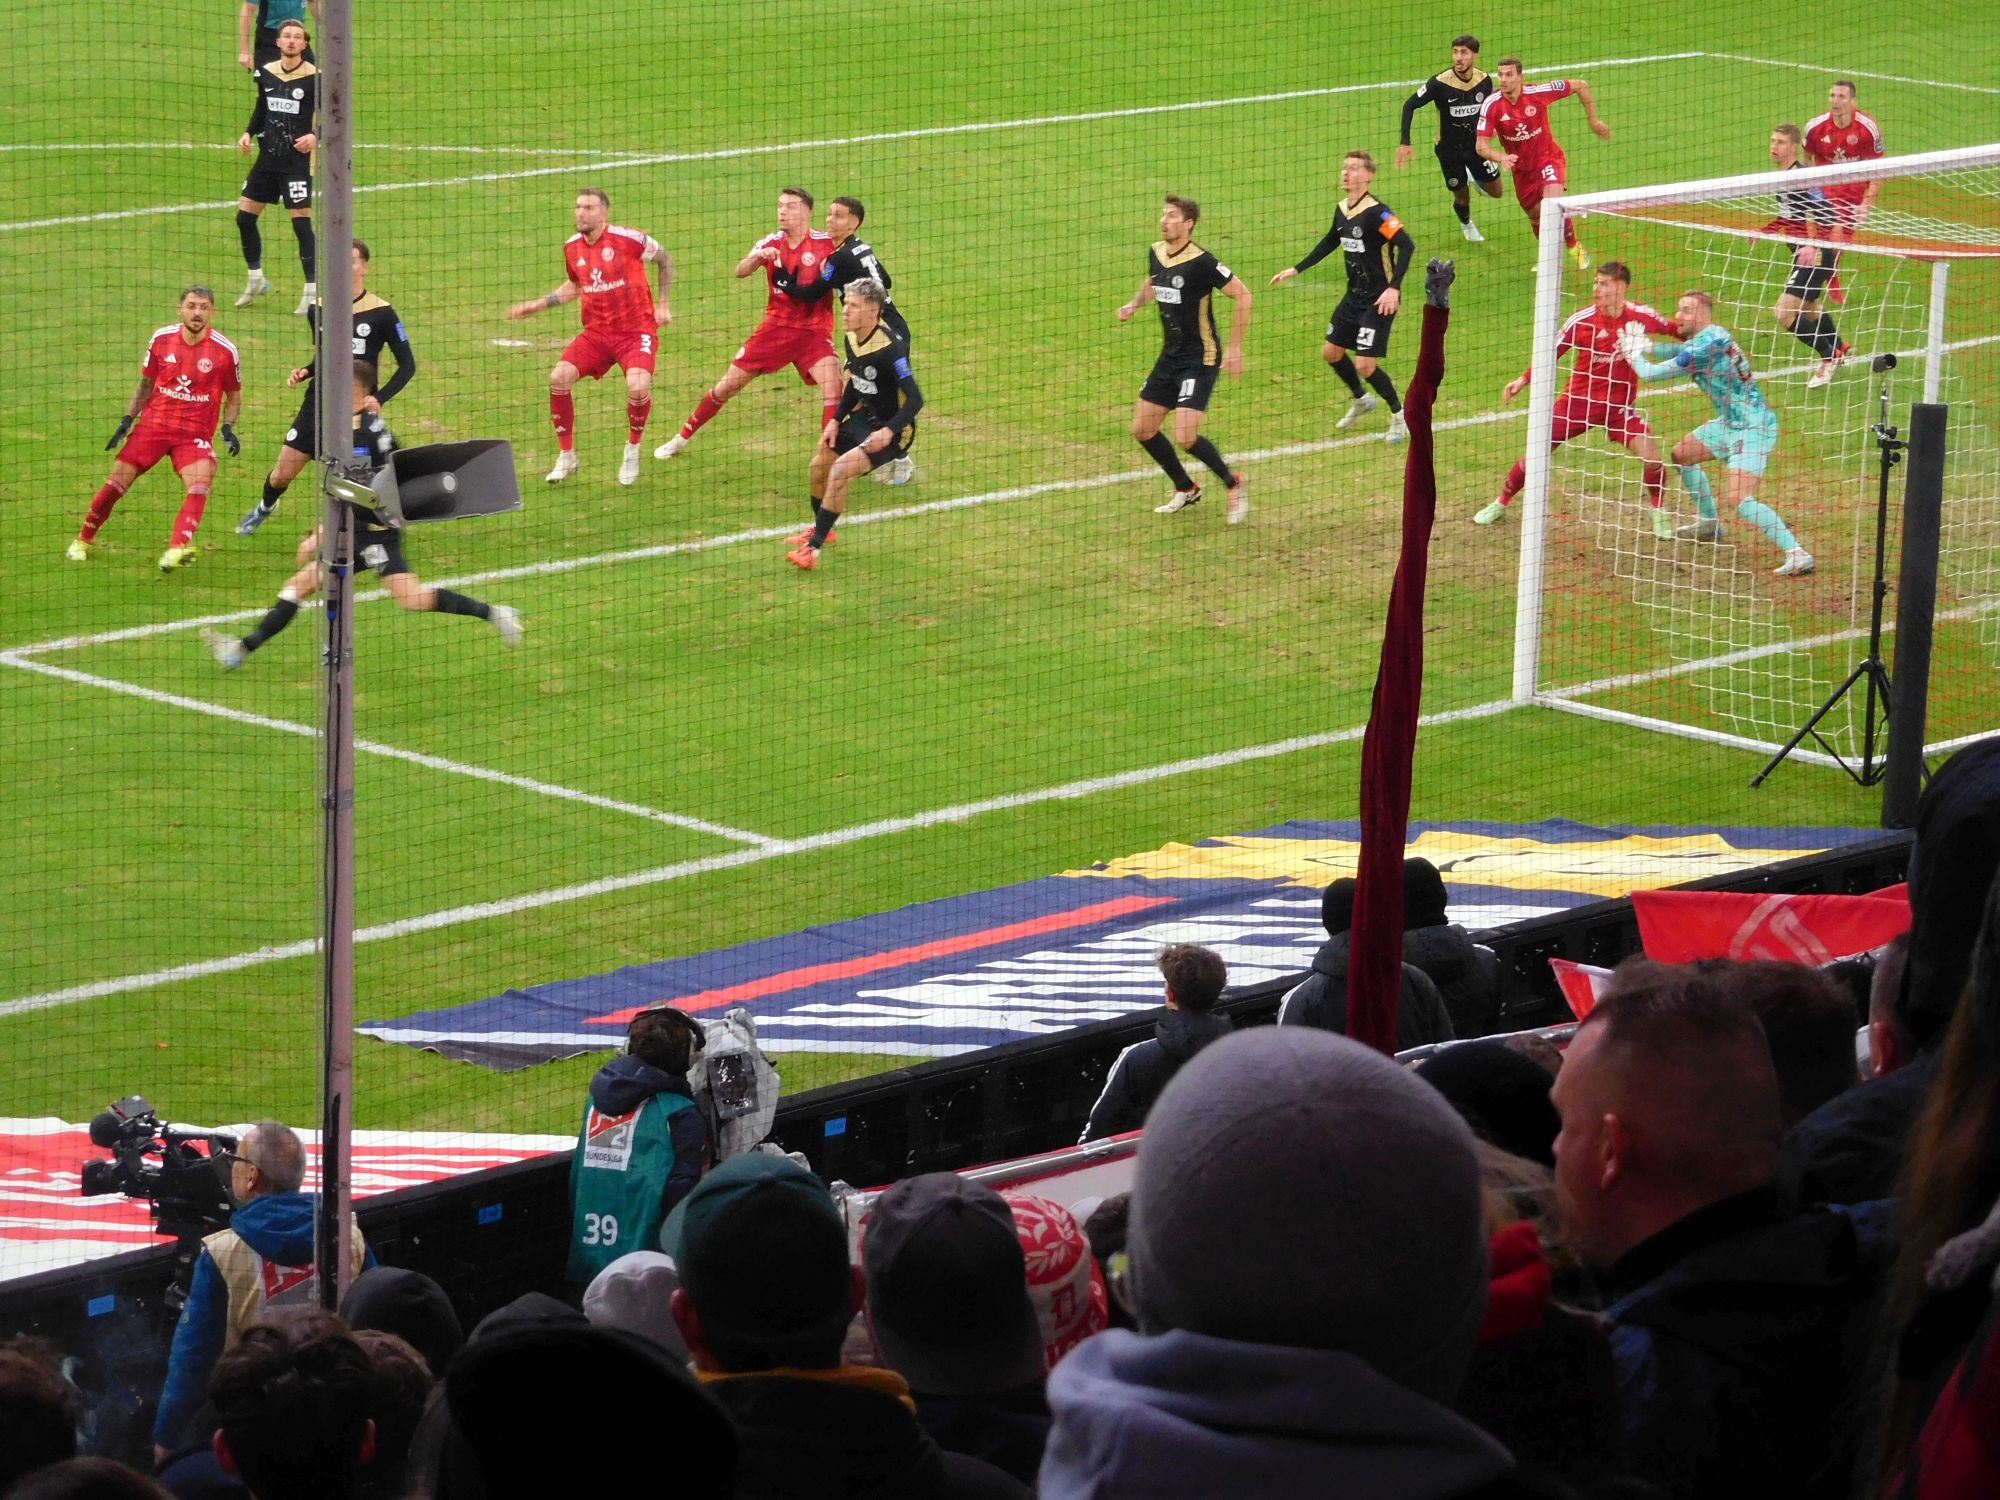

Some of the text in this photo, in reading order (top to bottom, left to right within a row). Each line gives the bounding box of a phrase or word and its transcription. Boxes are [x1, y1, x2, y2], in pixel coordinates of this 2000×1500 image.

[1541, 164, 1555, 178] 15
[288, 180, 308, 199] 25
[640, 333, 652, 346] 3
[159, 386, 210, 402] TARGOBANK
[1178, 378, 1197, 397] 11
[611, 1124, 627, 1147] 2
[582, 1212, 618, 1246] 39
